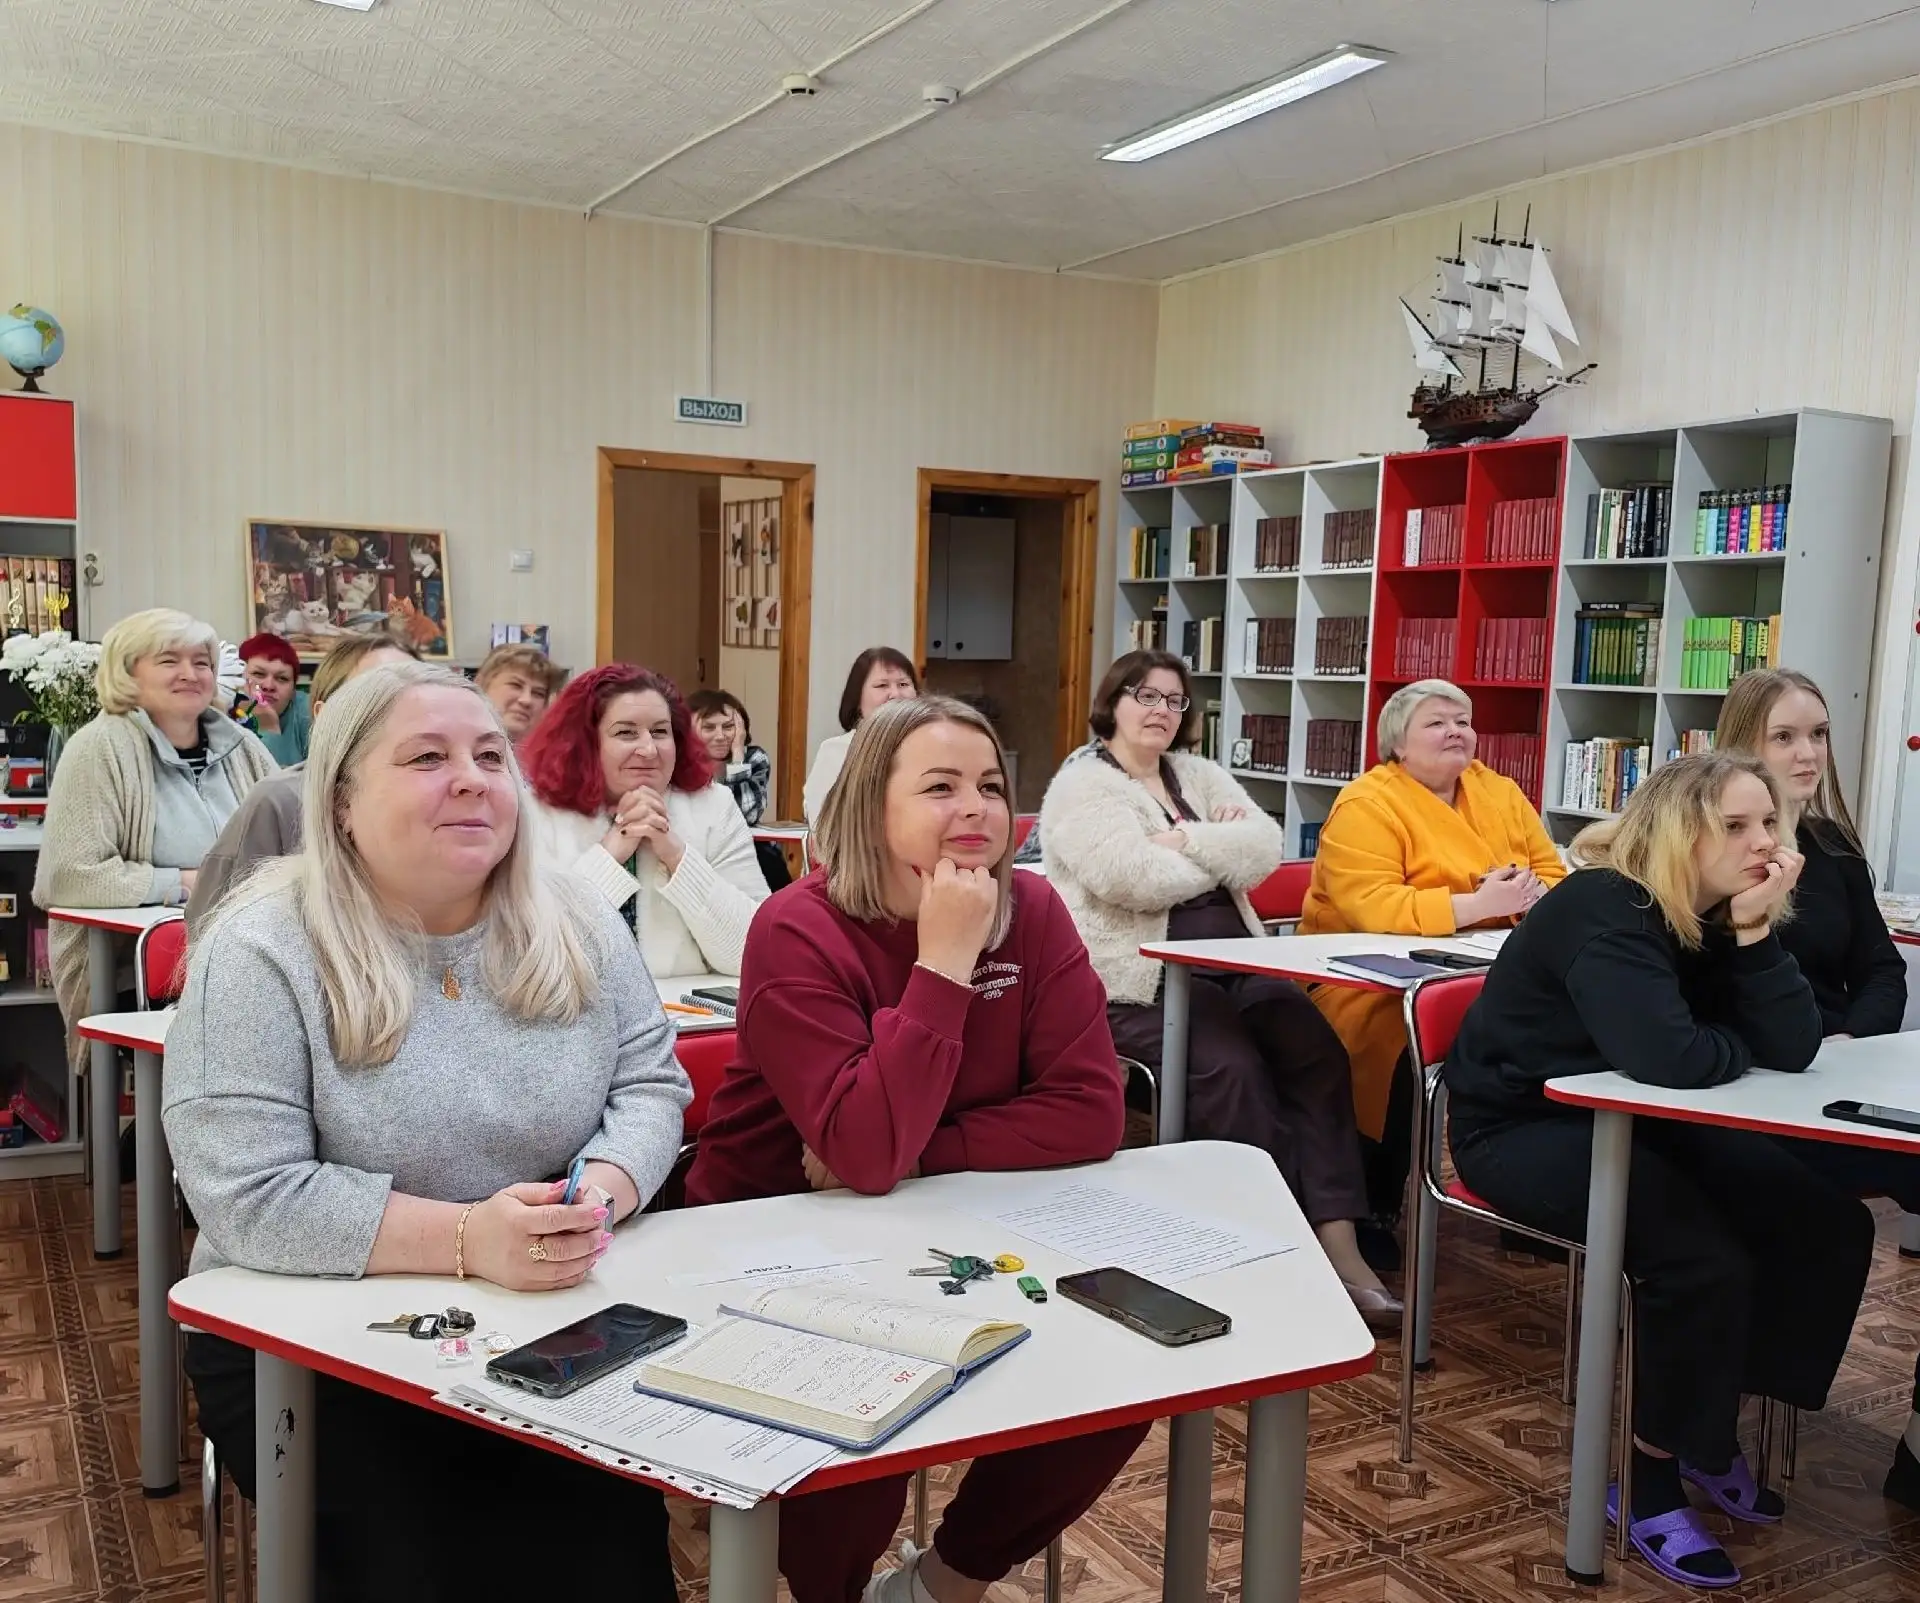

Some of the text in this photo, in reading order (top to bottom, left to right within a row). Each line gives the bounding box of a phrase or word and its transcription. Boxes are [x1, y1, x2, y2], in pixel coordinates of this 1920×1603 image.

[683, 400, 740, 420] ВЫХОД
[972, 960, 1022, 979] ere Forever
[893, 1370, 916, 1383] 26
[855, 1403, 876, 1415] 27
